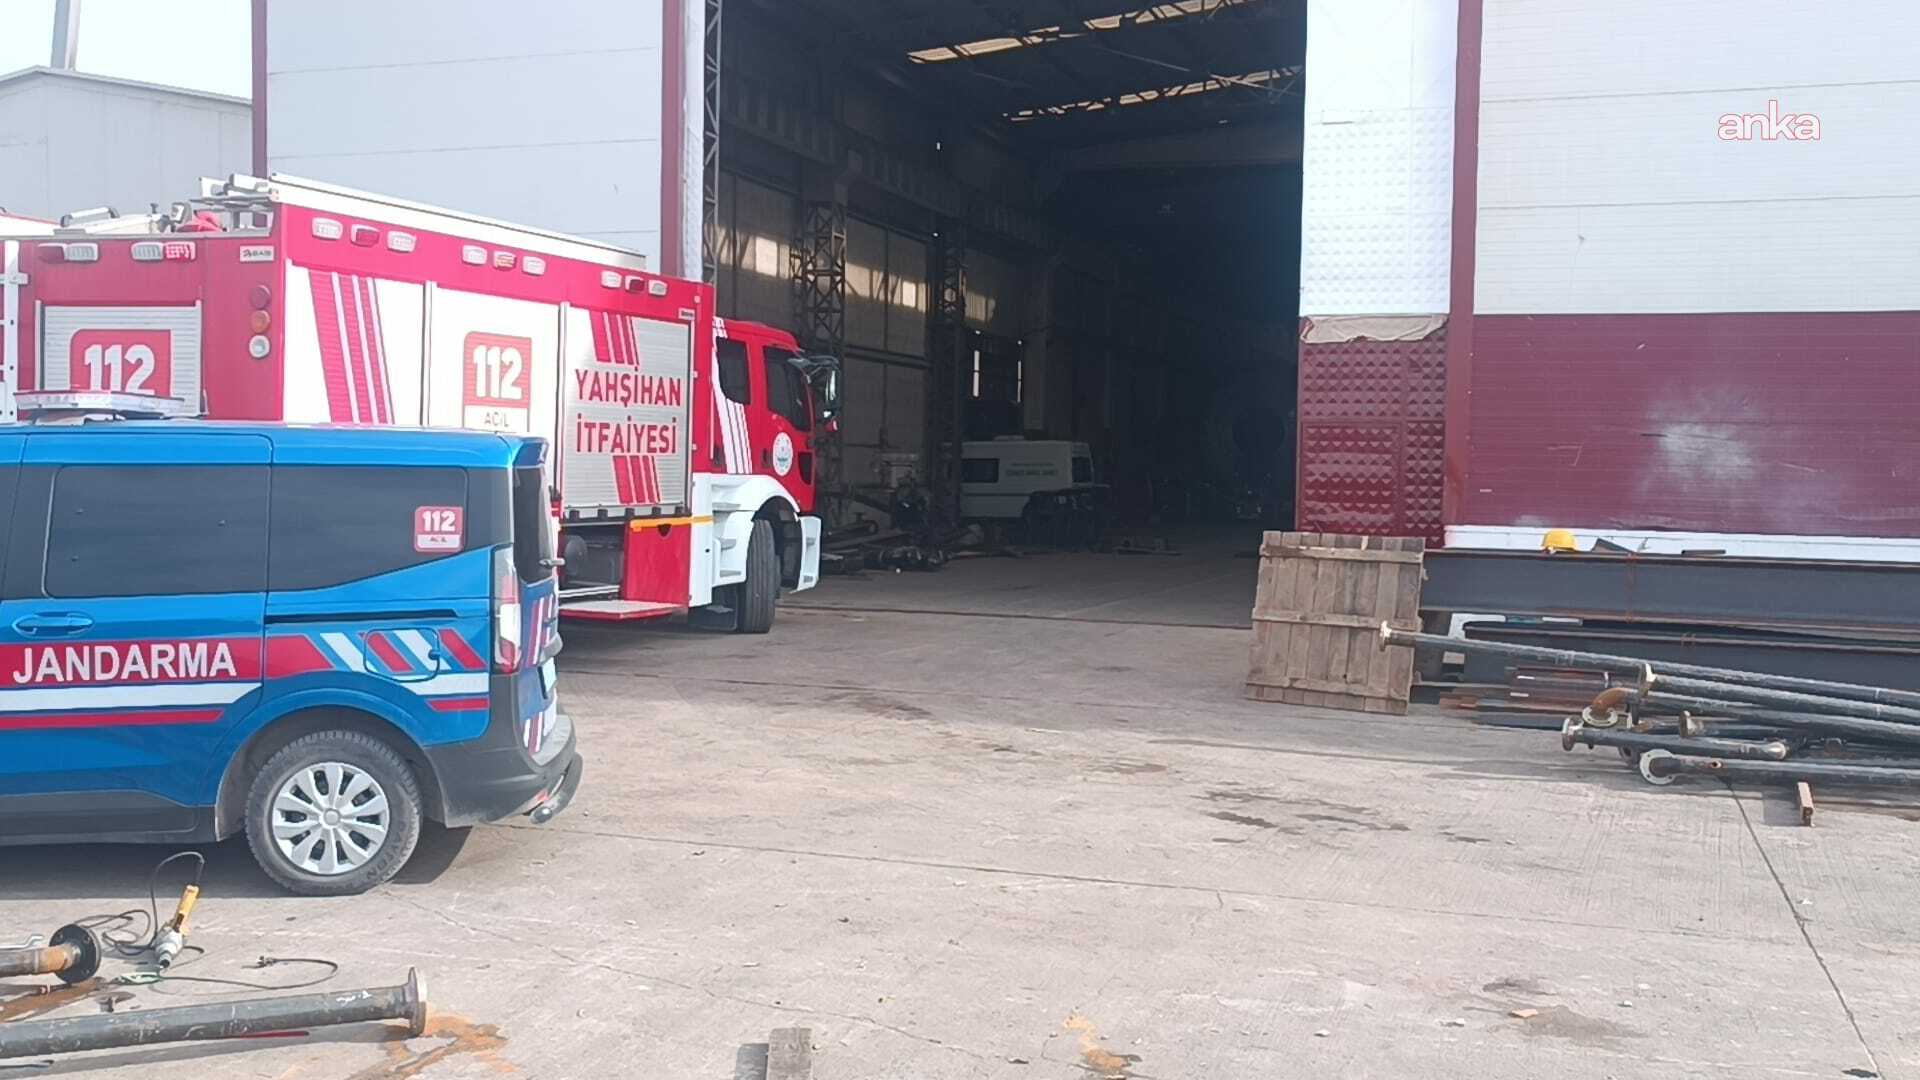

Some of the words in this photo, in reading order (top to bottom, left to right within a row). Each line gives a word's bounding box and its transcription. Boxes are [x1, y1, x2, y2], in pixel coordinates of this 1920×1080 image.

[84, 343, 155, 395] 112
[473, 344, 523, 400] 112
[575, 366, 681, 408] YAHŞİHAN
[576, 412, 677, 454] İTFAİYESİ
[422, 510, 456, 532] 112
[12, 642, 238, 684] JANDARMA
